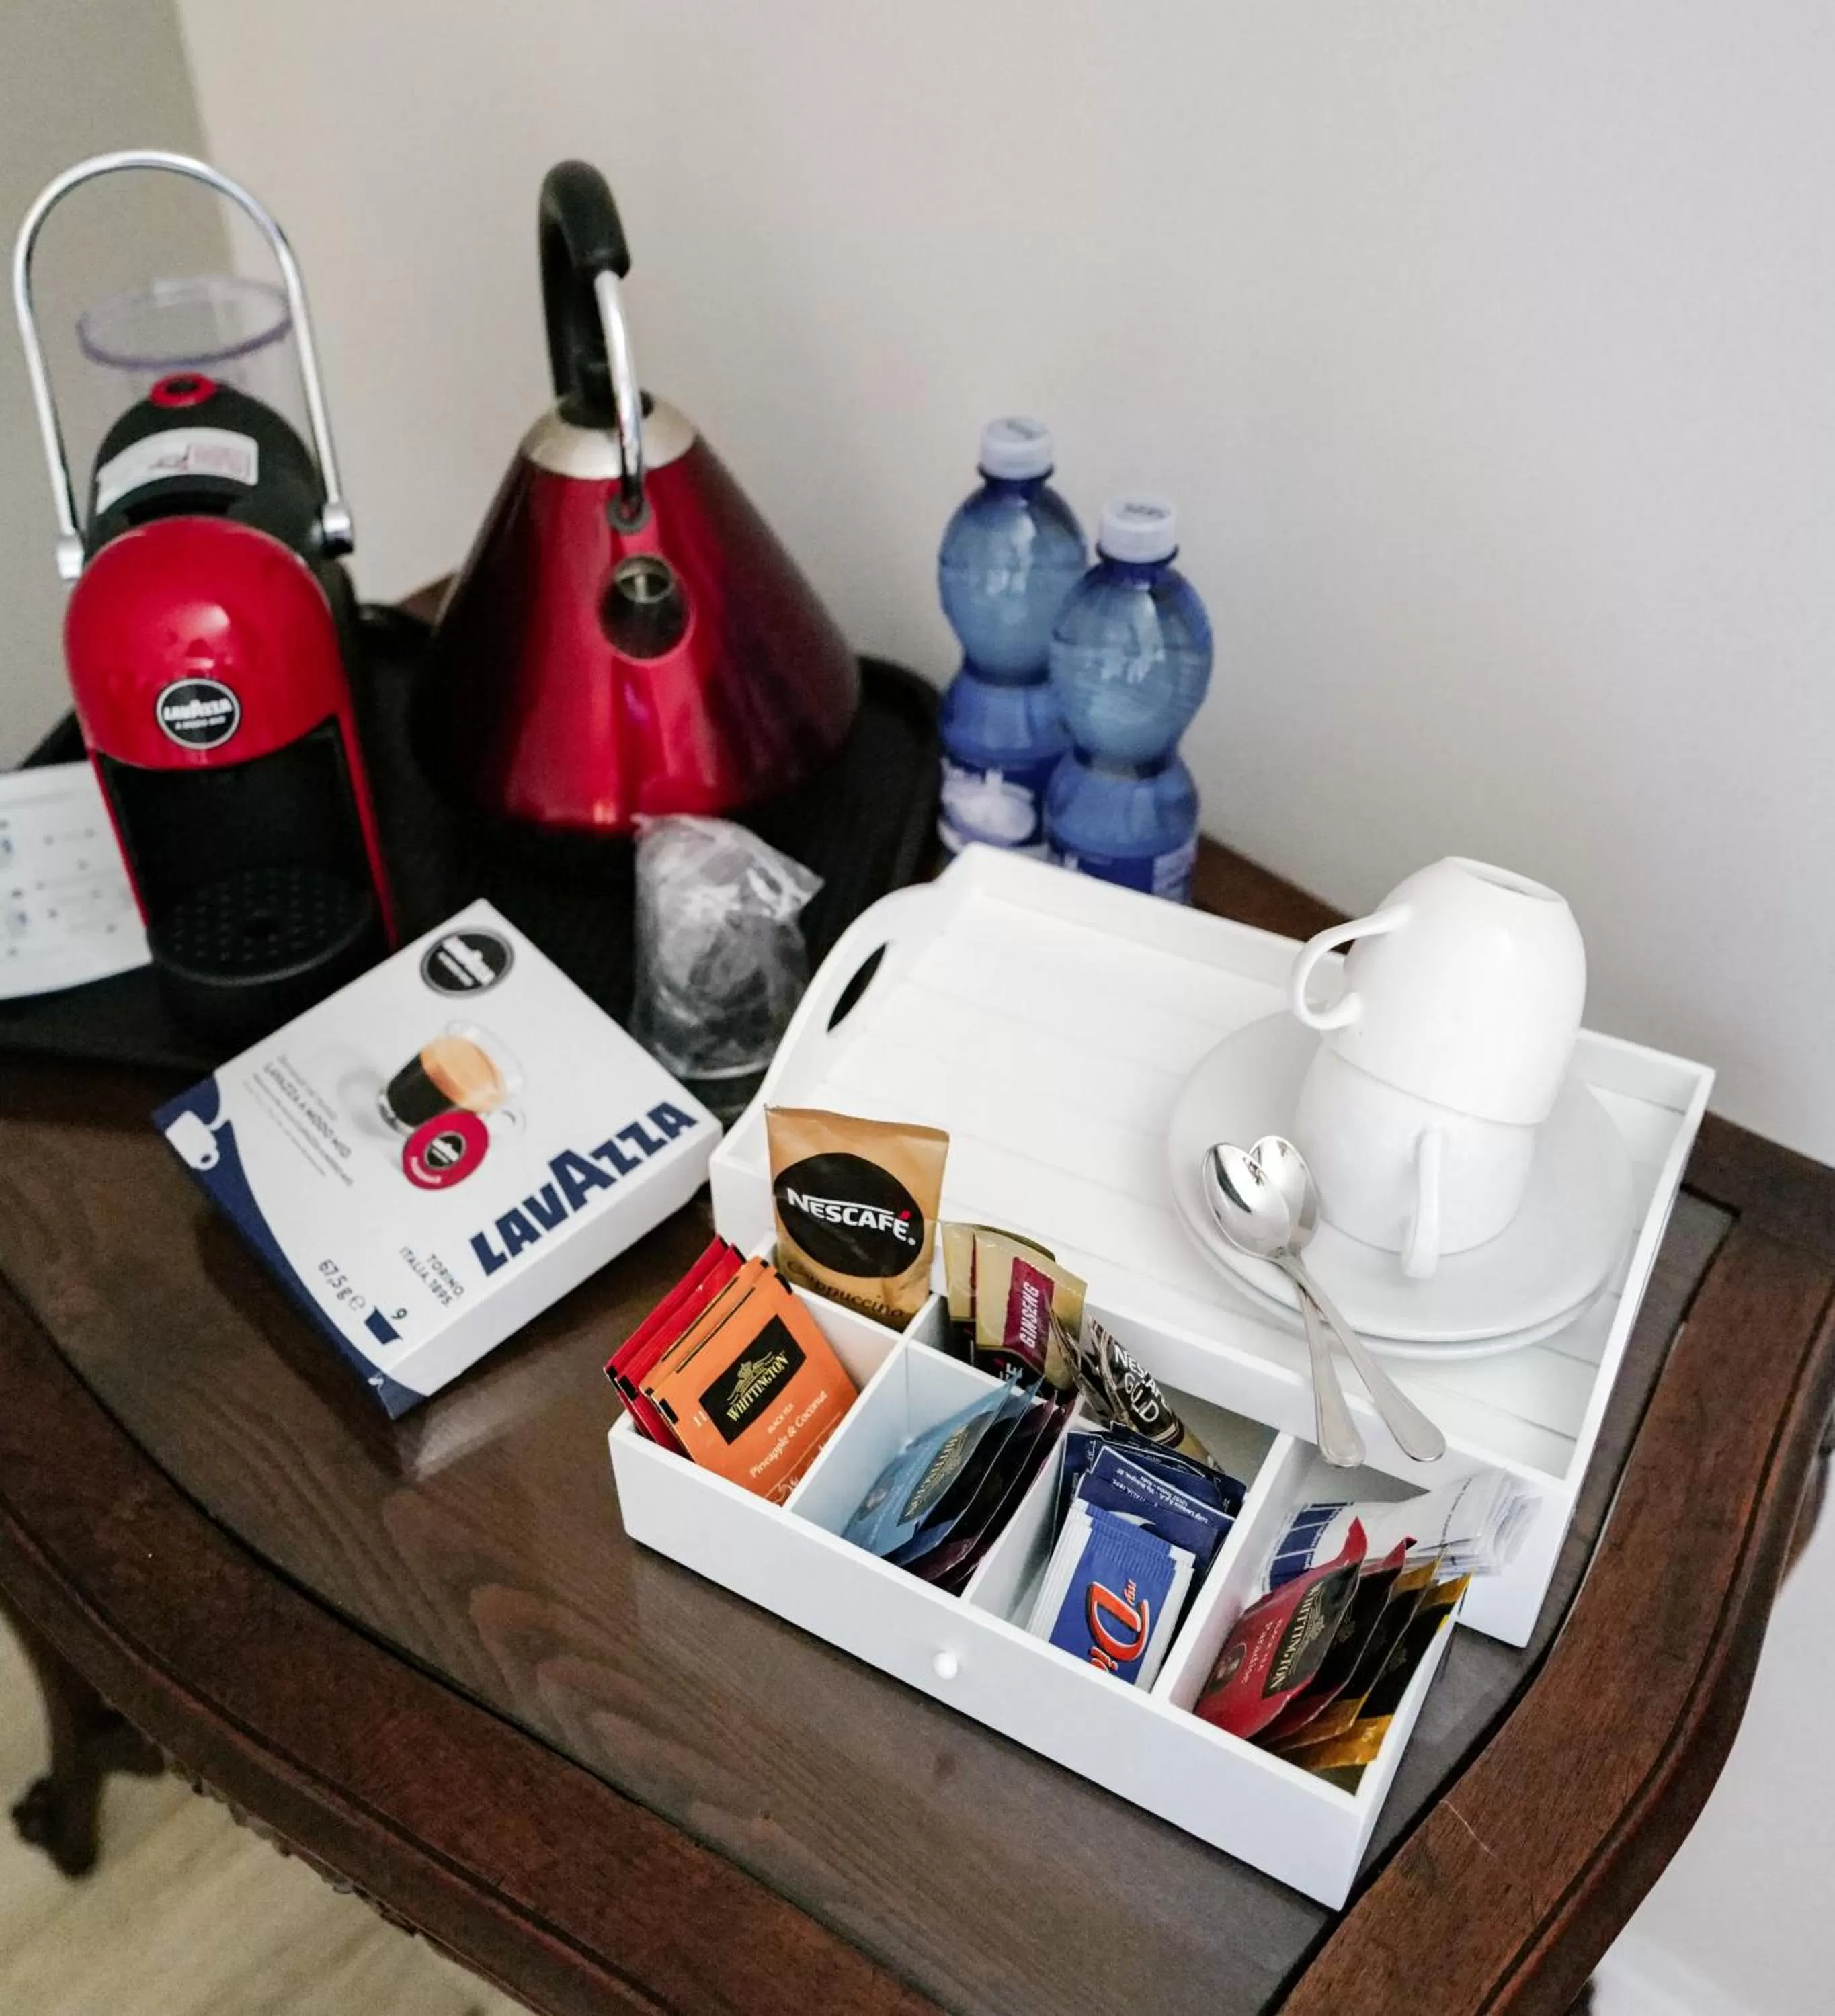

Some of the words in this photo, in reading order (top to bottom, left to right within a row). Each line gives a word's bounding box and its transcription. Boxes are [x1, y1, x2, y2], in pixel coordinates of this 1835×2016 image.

[469, 1101, 699, 1277] LAVAZZA
[318, 1259, 348, 1288] 67,5
[336, 1286, 352, 1300] g
[391, 1308, 407, 1320] 9
[1019, 1281, 1040, 1349] GINSENG
[726, 1353, 789, 1422] WHITTINGTON
[1125, 1372, 1159, 1423] GOLD
[750, 1435, 790, 1478] Pineapple
[787, 1425, 797, 1437] &
[795, 1390, 828, 1428] Coconut
[1123, 1577, 1137, 1606] my
